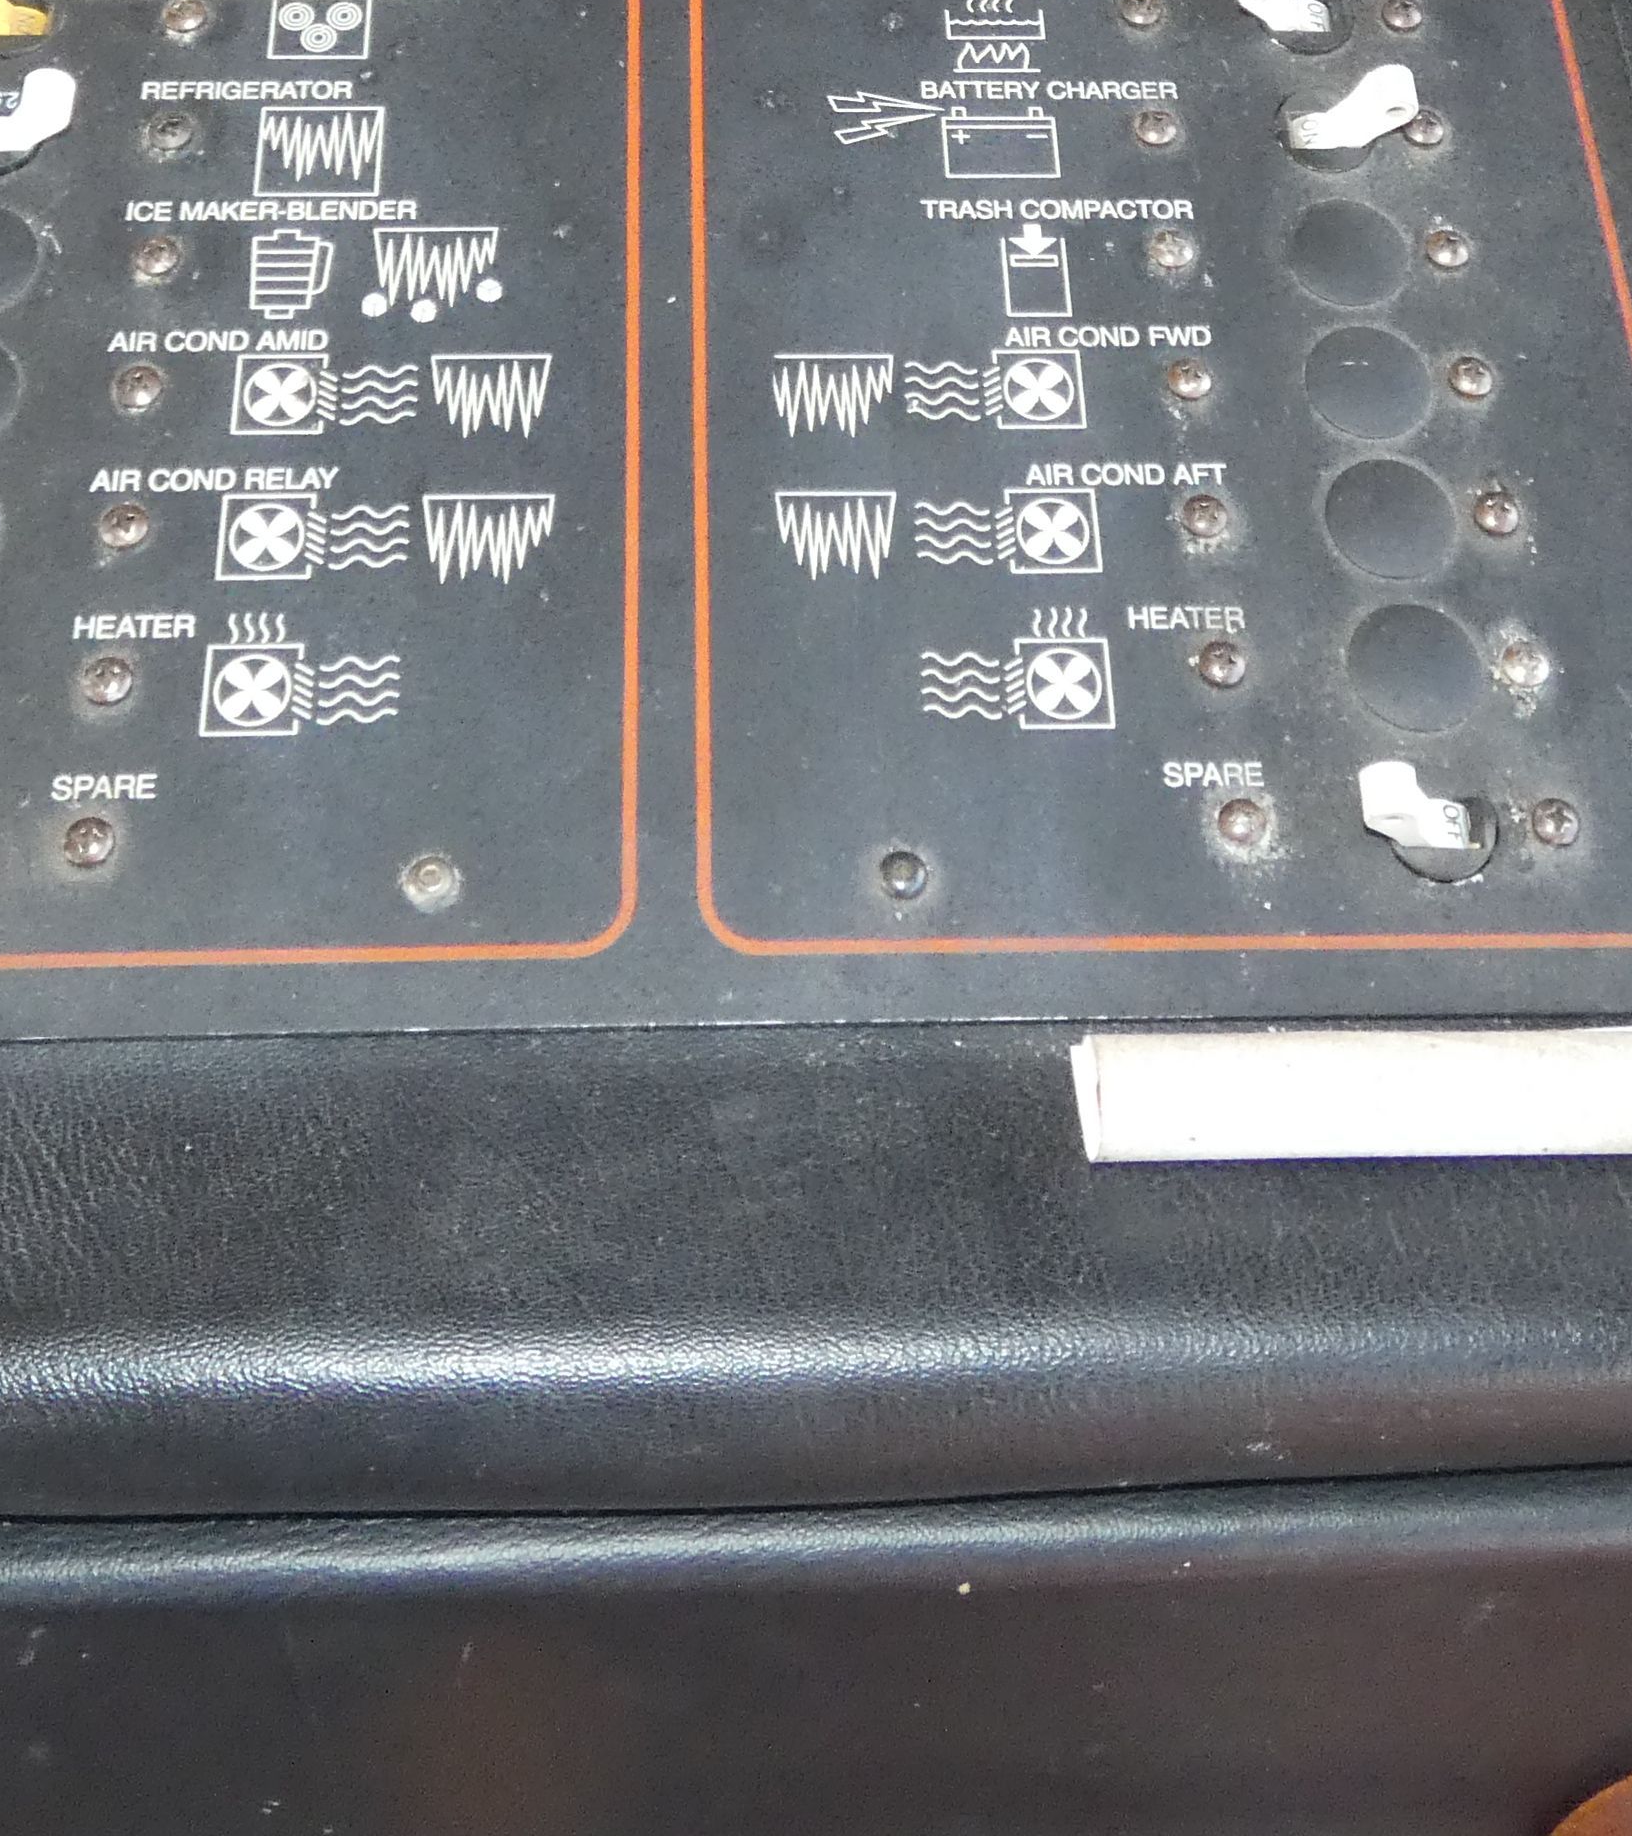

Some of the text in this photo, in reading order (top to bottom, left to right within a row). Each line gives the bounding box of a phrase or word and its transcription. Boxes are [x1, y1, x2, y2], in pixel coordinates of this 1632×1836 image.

[140, 80, 354, 101] REFRIGERATOR
[920, 81, 1178, 101] BATTERY CHARGER
[126, 200, 418, 223] ICE MAKER-BLENDER
[921, 199, 1194, 221] TRASH COMPACTOR
[108, 330, 329, 353] AIR COND AMID
[1005, 326, 1212, 347] AIR COND FWD
[89, 467, 340, 493] AIR COND RELAY
[1026, 464, 1227, 486] AIR COND AFT
[73, 615, 196, 640] HEATER
[1128, 608, 1245, 631] HEATER
[1163, 762, 1266, 788] SPARE
[51, 774, 158, 801] SPARE
